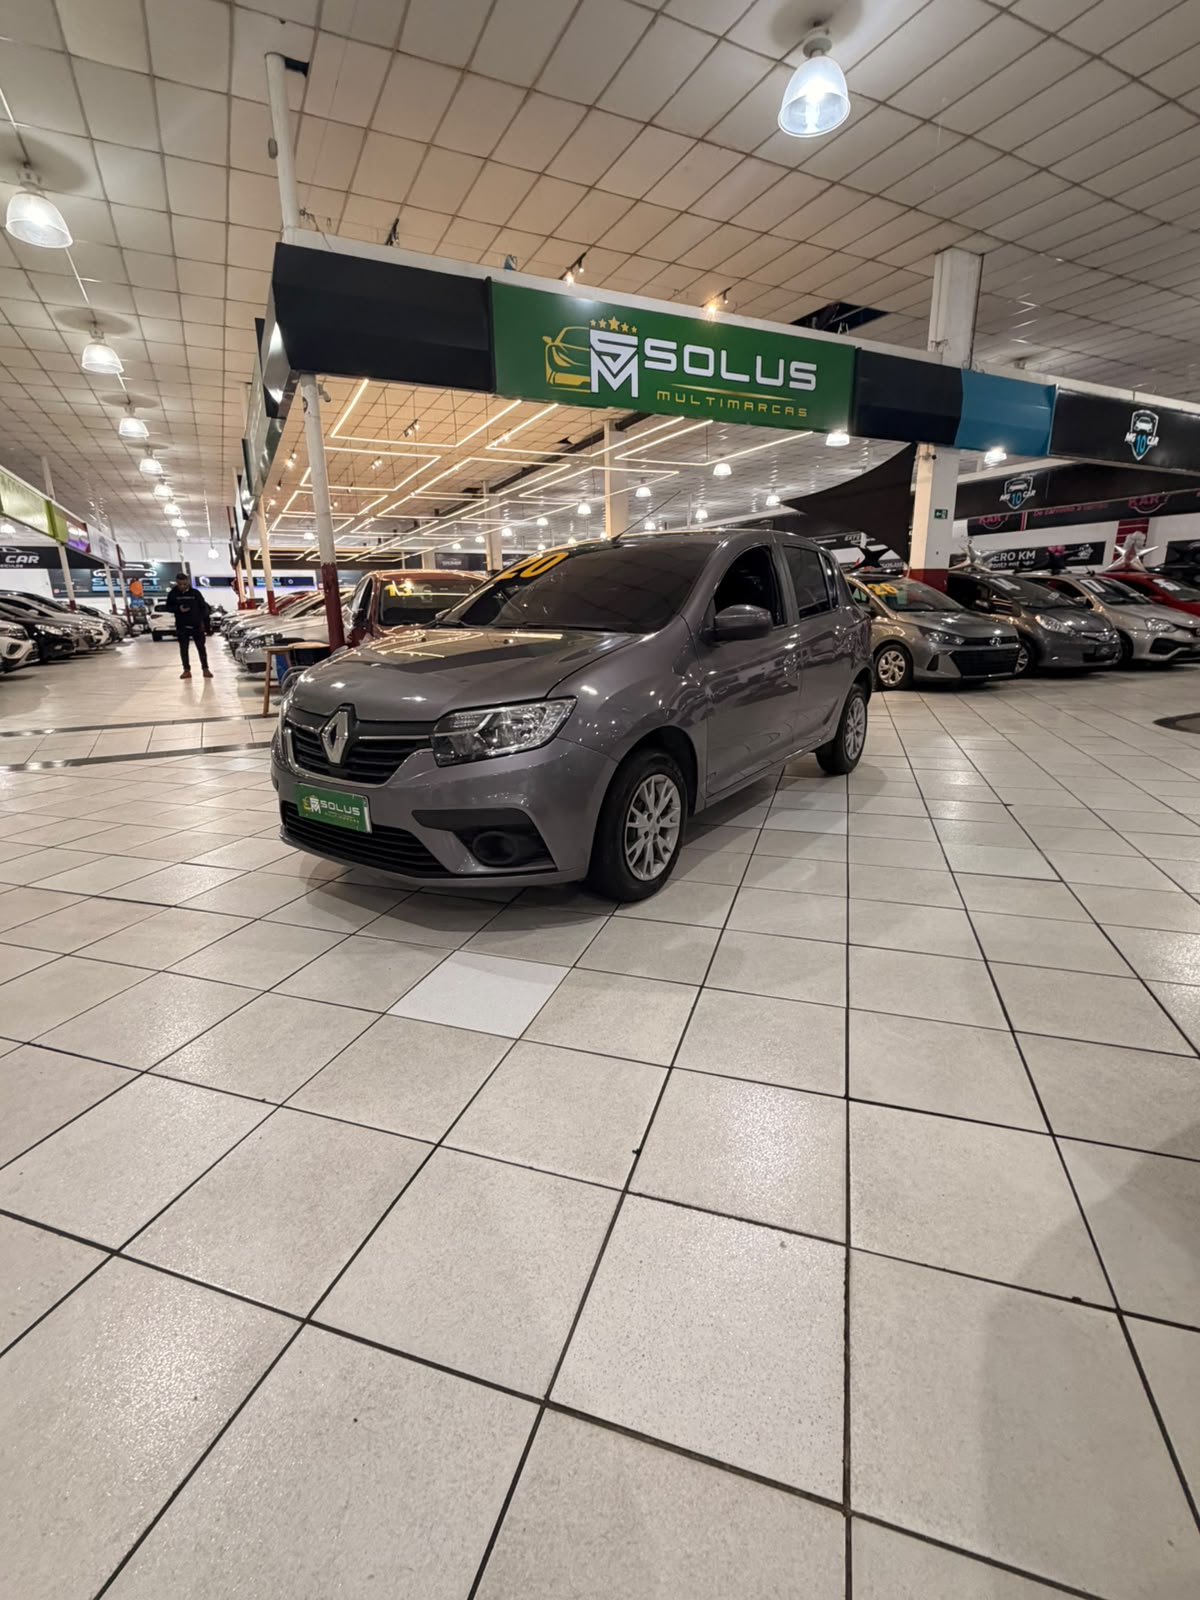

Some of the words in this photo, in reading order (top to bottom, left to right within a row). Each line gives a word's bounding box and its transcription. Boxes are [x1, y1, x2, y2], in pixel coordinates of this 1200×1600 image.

[643, 337, 817, 392] SOLUS
[656, 390, 808, 418] MULTIMARCAS
[1136, 433, 1147, 454] 10
[1146, 435, 1160, 447] CAR
[1012, 491, 1022, 506] 10
[1022, 489, 1037, 498] CAR
[5, 555, 40, 564] CAR
[1018, 549, 1037, 561] KM
[495, 552, 569, 580] 20
[320, 800, 360, 816] SOLUS
